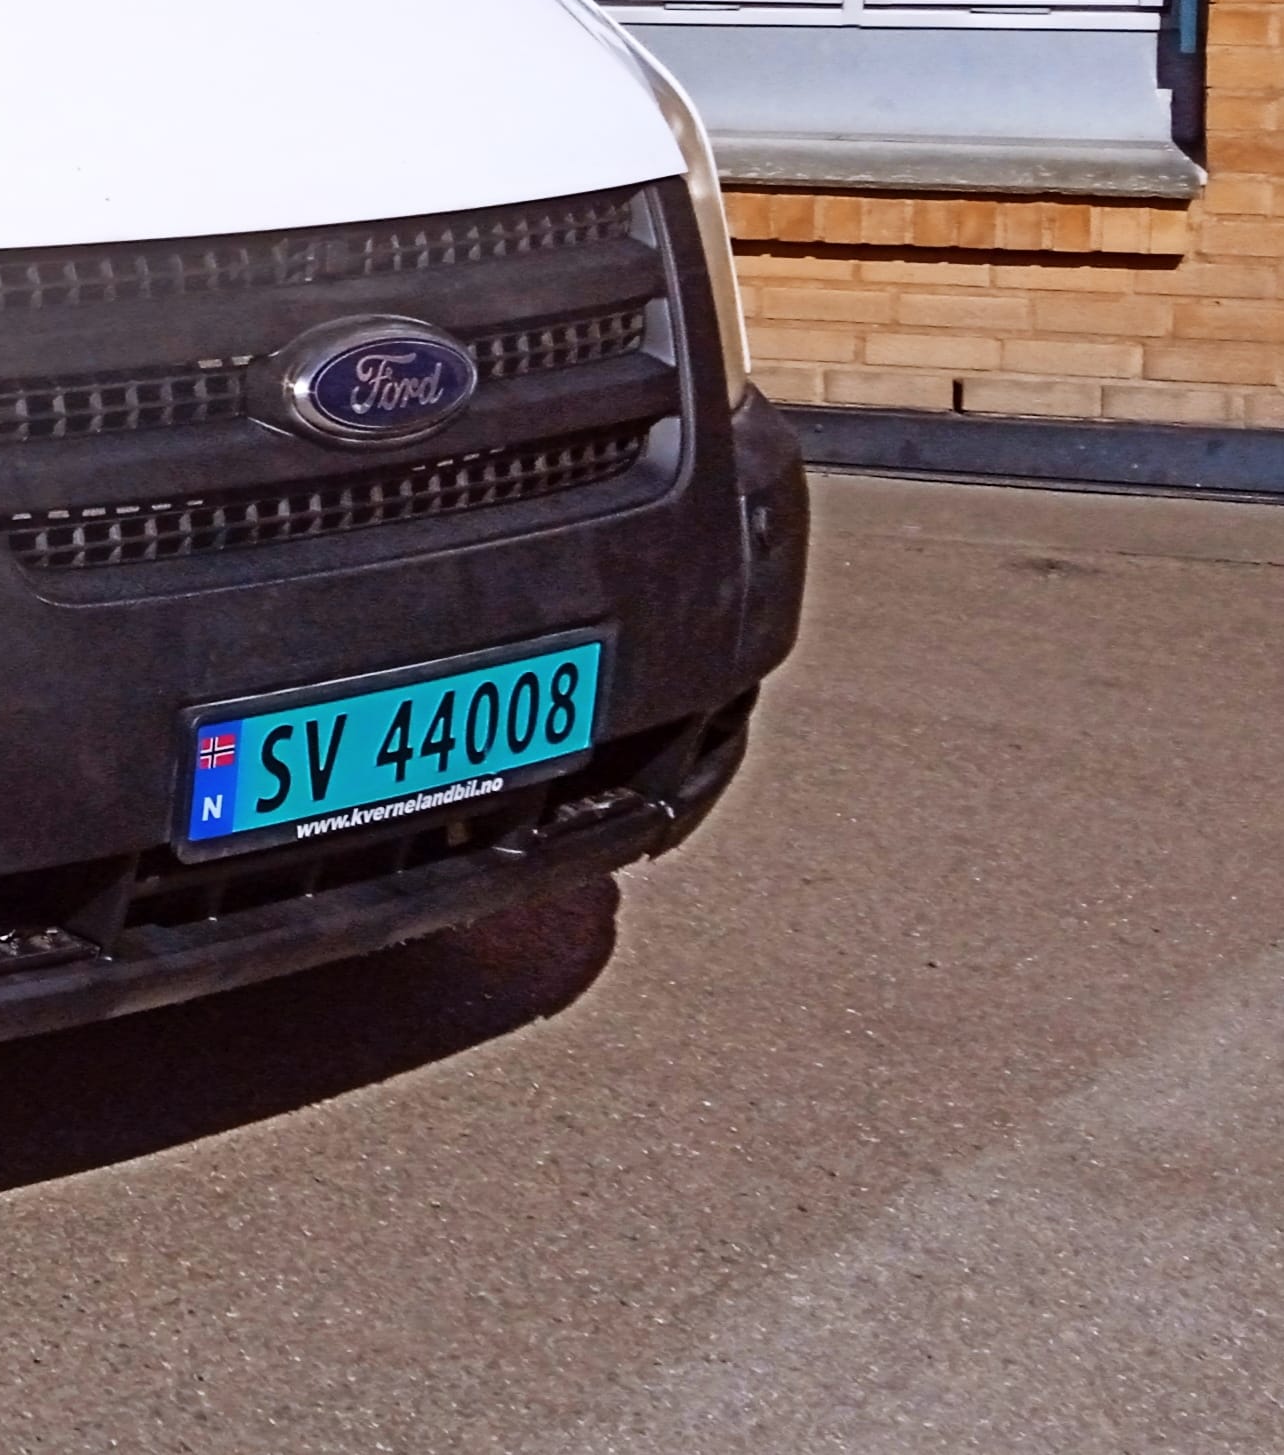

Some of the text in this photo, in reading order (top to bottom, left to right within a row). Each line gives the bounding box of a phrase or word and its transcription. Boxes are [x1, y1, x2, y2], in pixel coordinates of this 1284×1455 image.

[350, 352, 444, 415] Ford
[255, 662, 579, 814] SV 44008
[201, 793, 223, 821] N
[296, 775, 505, 840] www.kvernelandbil.no
